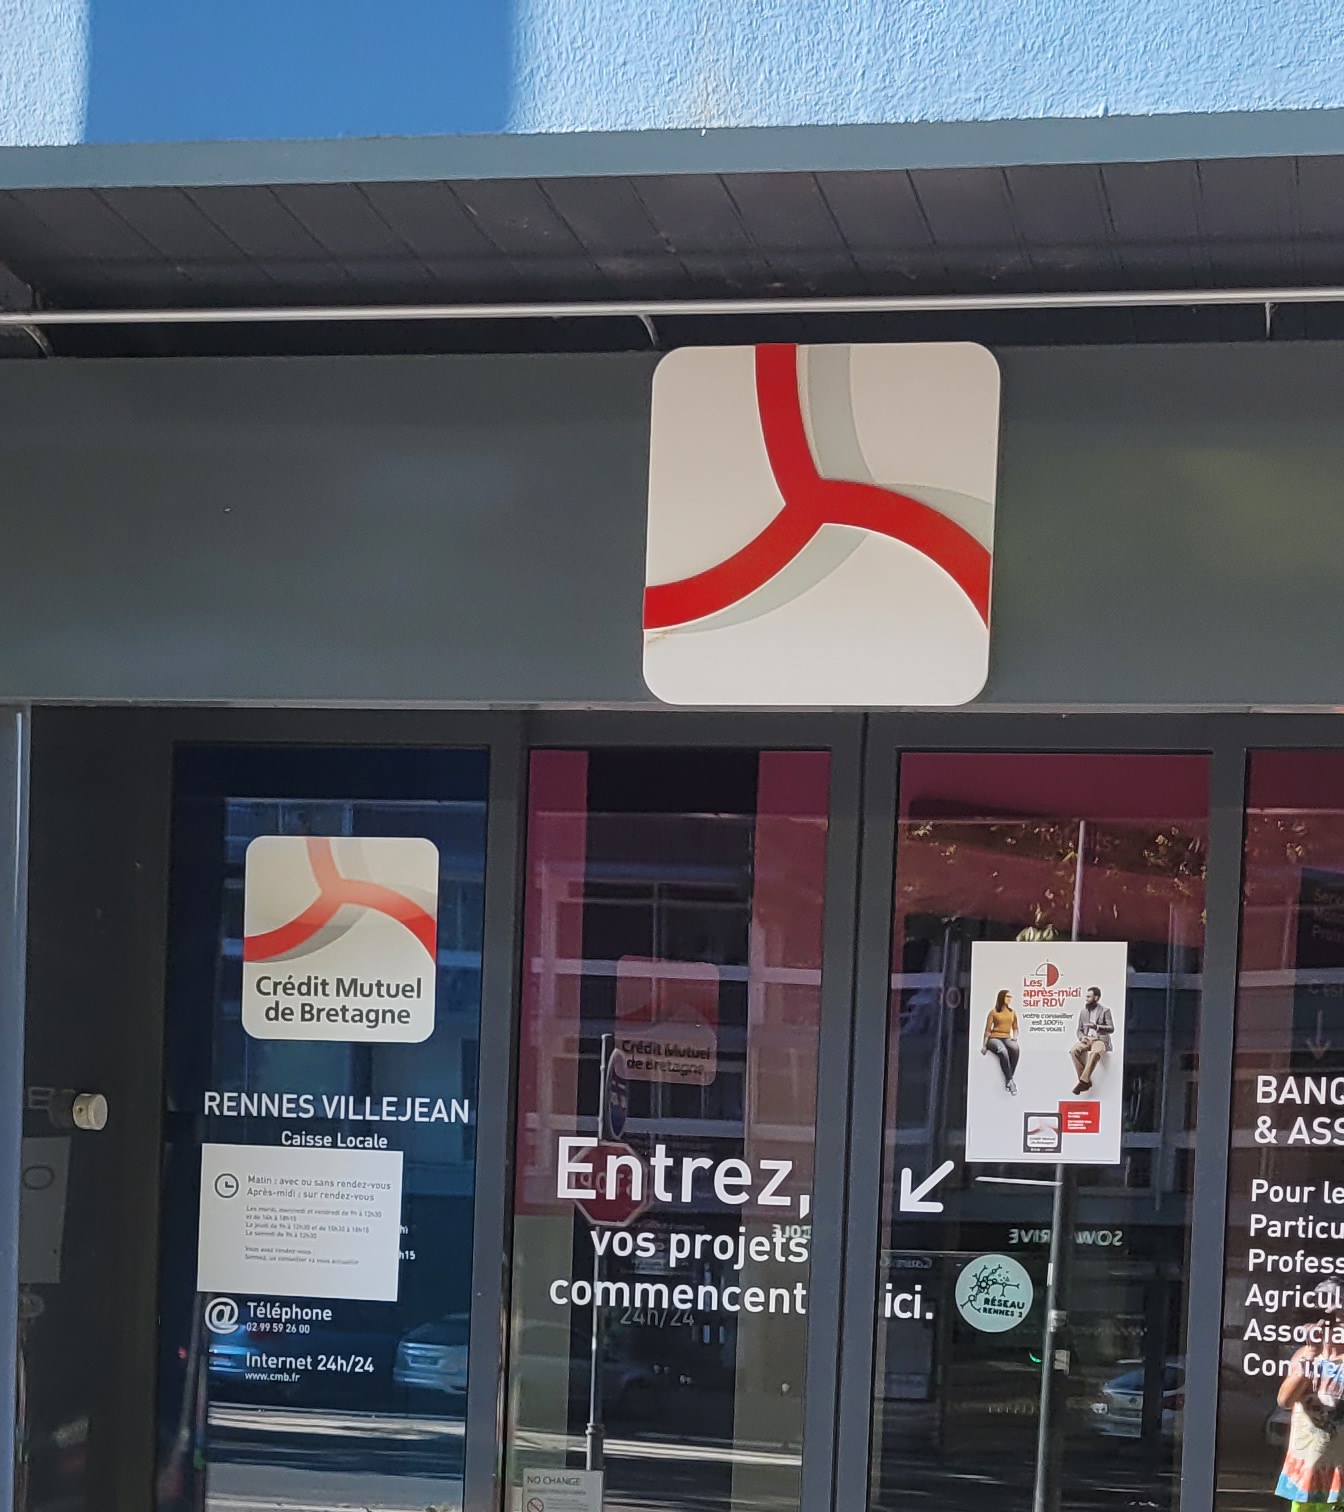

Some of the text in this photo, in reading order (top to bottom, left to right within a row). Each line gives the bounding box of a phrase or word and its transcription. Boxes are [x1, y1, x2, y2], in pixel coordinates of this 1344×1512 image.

[255, 974, 422, 1000] Crédit Mutuel
[1024, 977, 1042, 987] Les
[1023, 987, 1081, 999] après-midi
[1023, 998, 1065, 1007] sur RDV
[264, 1002, 411, 1028] de Bretagne
[204, 1091, 470, 1124] RENNES VILLEJEAN
[1254, 1115, 1278, 1144] &
[281, 1131, 388, 1149] Caisse Locale
[248, 1175, 271, 1184] Matin
[336, 1181, 391, 1190] rendez-vous
[557, 1136, 810, 1219] Entrez,
[247, 1187, 295, 1197] Après-midi
[320, 1191, 374, 1201] rendez-vous
[1251, 1179, 1315, 1203] Pour
[590, 1226, 809, 1269] vos projets
[549, 1279, 934, 1320] commencent ici.
[984, 1296, 1025, 1309] RÉSEAU
[247, 1301, 332, 1321] Téléphone
[983, 1307, 1014, 1317] RENNES
[246, 1323, 310, 1333] 02 99 59 26 00
[246, 1352, 374, 1373] Internet 24h/24
[245, 1371, 300, 1382] www.cmb.fr
[527, 1476, 581, 1486] NO CHANGE
